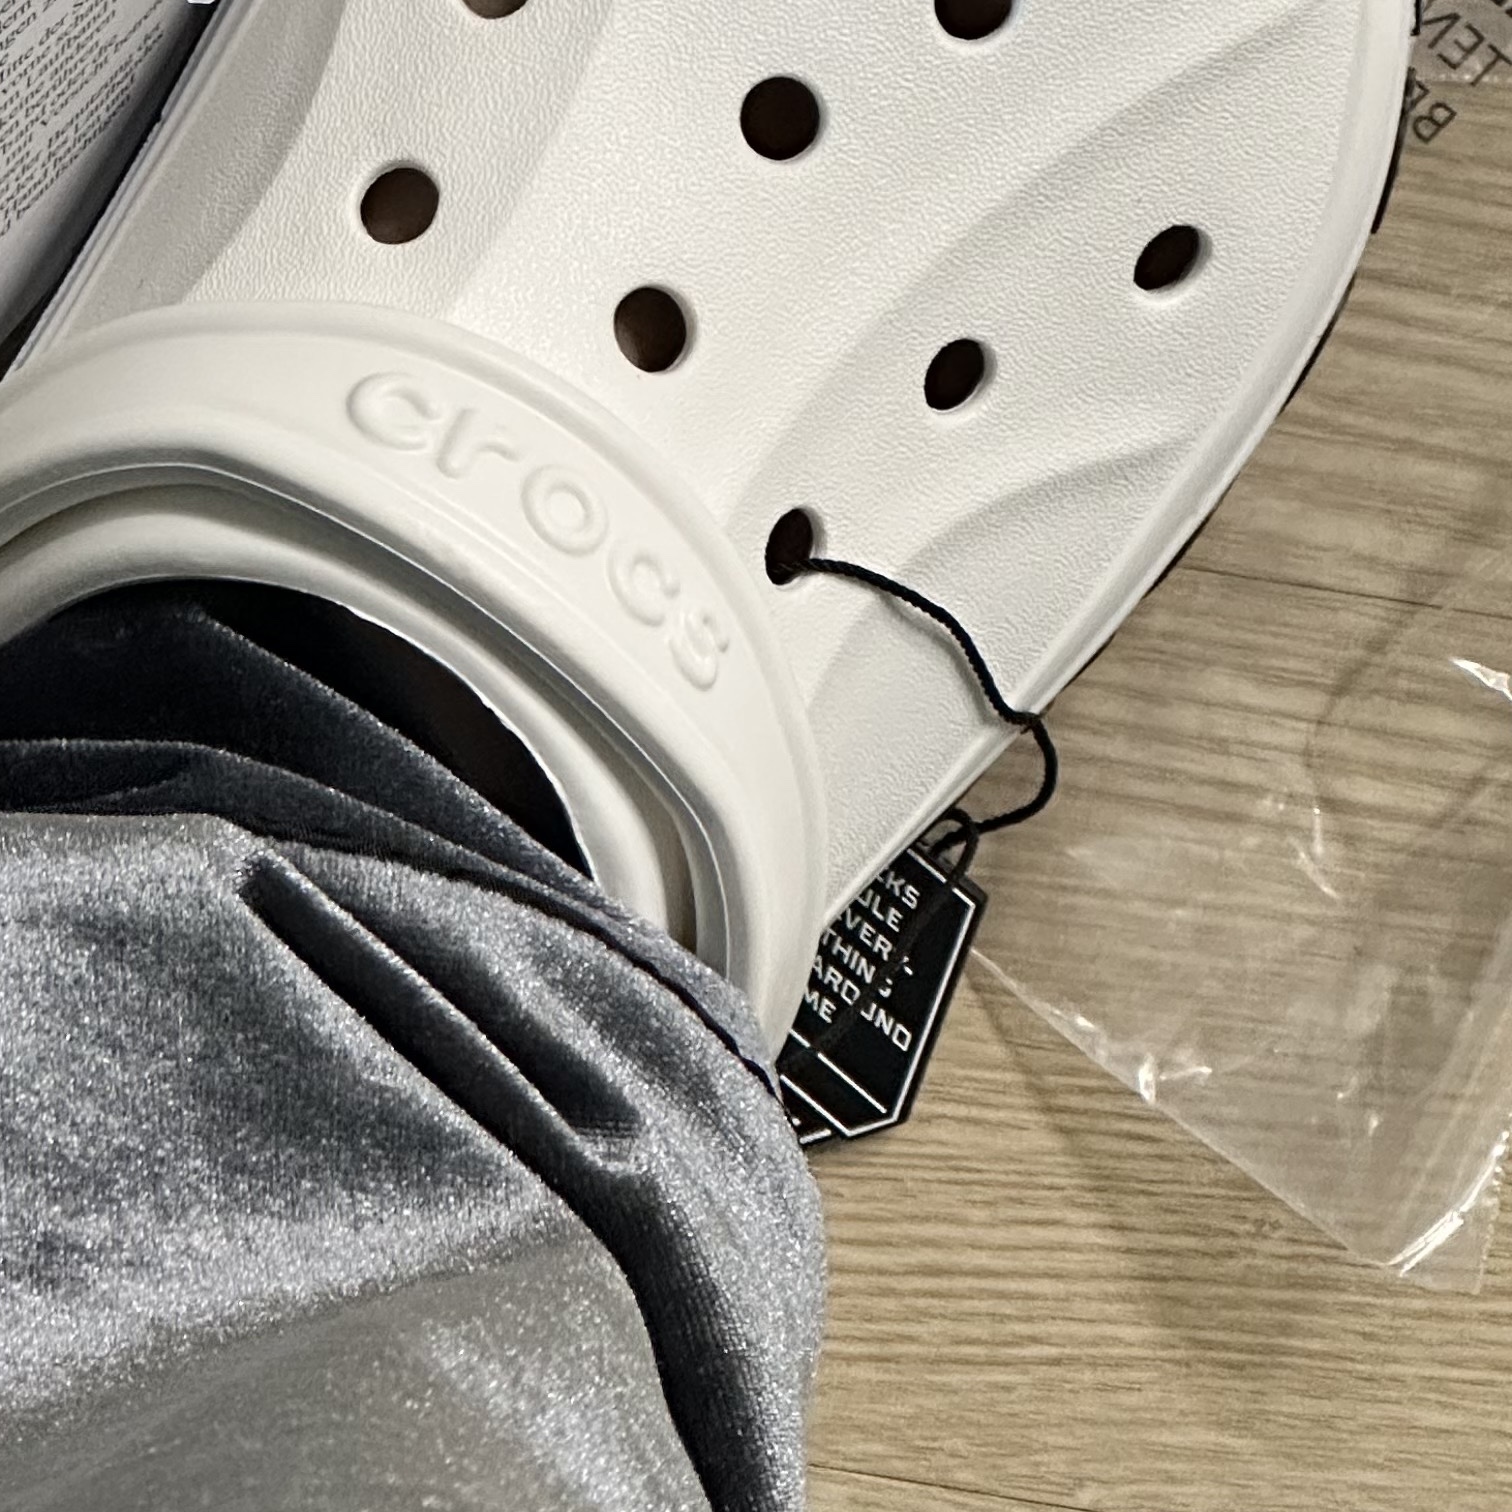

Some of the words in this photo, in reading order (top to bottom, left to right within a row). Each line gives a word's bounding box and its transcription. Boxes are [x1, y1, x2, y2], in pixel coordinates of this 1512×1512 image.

[25, 0, 108, 89] Laufband
[37, 12, 69, 46] der
[49, 9, 116, 80] anderen
[0, 44, 51, 93] vorne
[5, 132, 33, 165] mit
[345, 371, 730, 691] crocs
